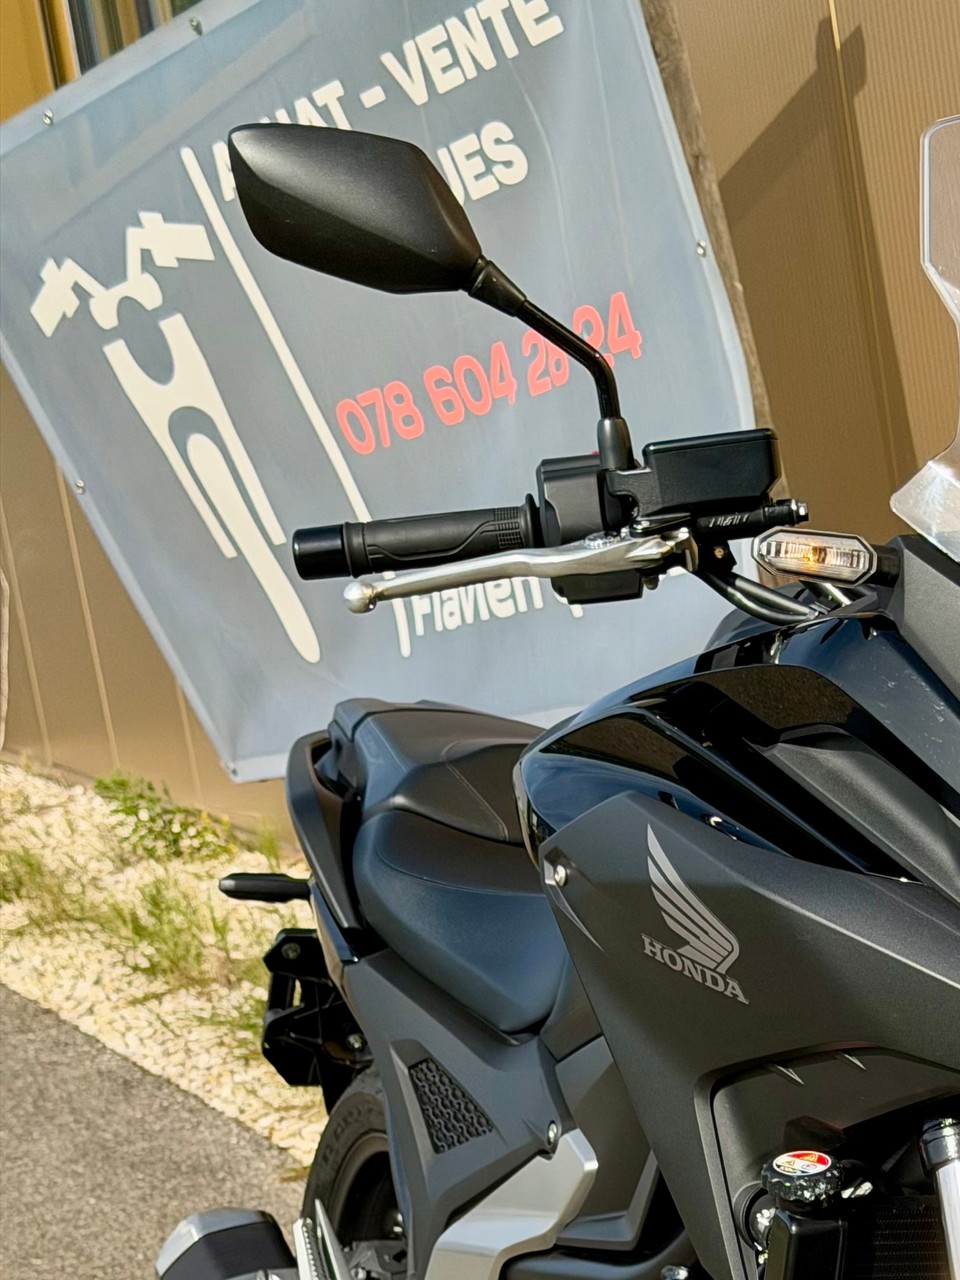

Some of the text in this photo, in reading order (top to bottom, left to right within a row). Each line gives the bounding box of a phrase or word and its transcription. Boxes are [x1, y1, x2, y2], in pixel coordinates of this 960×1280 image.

[379, 0, 565, 106] VENTE
[335, 381, 424, 455] 078
[422, 341, 518, 426] 604
[572, 291, 643, 368] 24
[410, 576, 544, 637] Flavien
[641, 932, 750, 1006] HONDA
